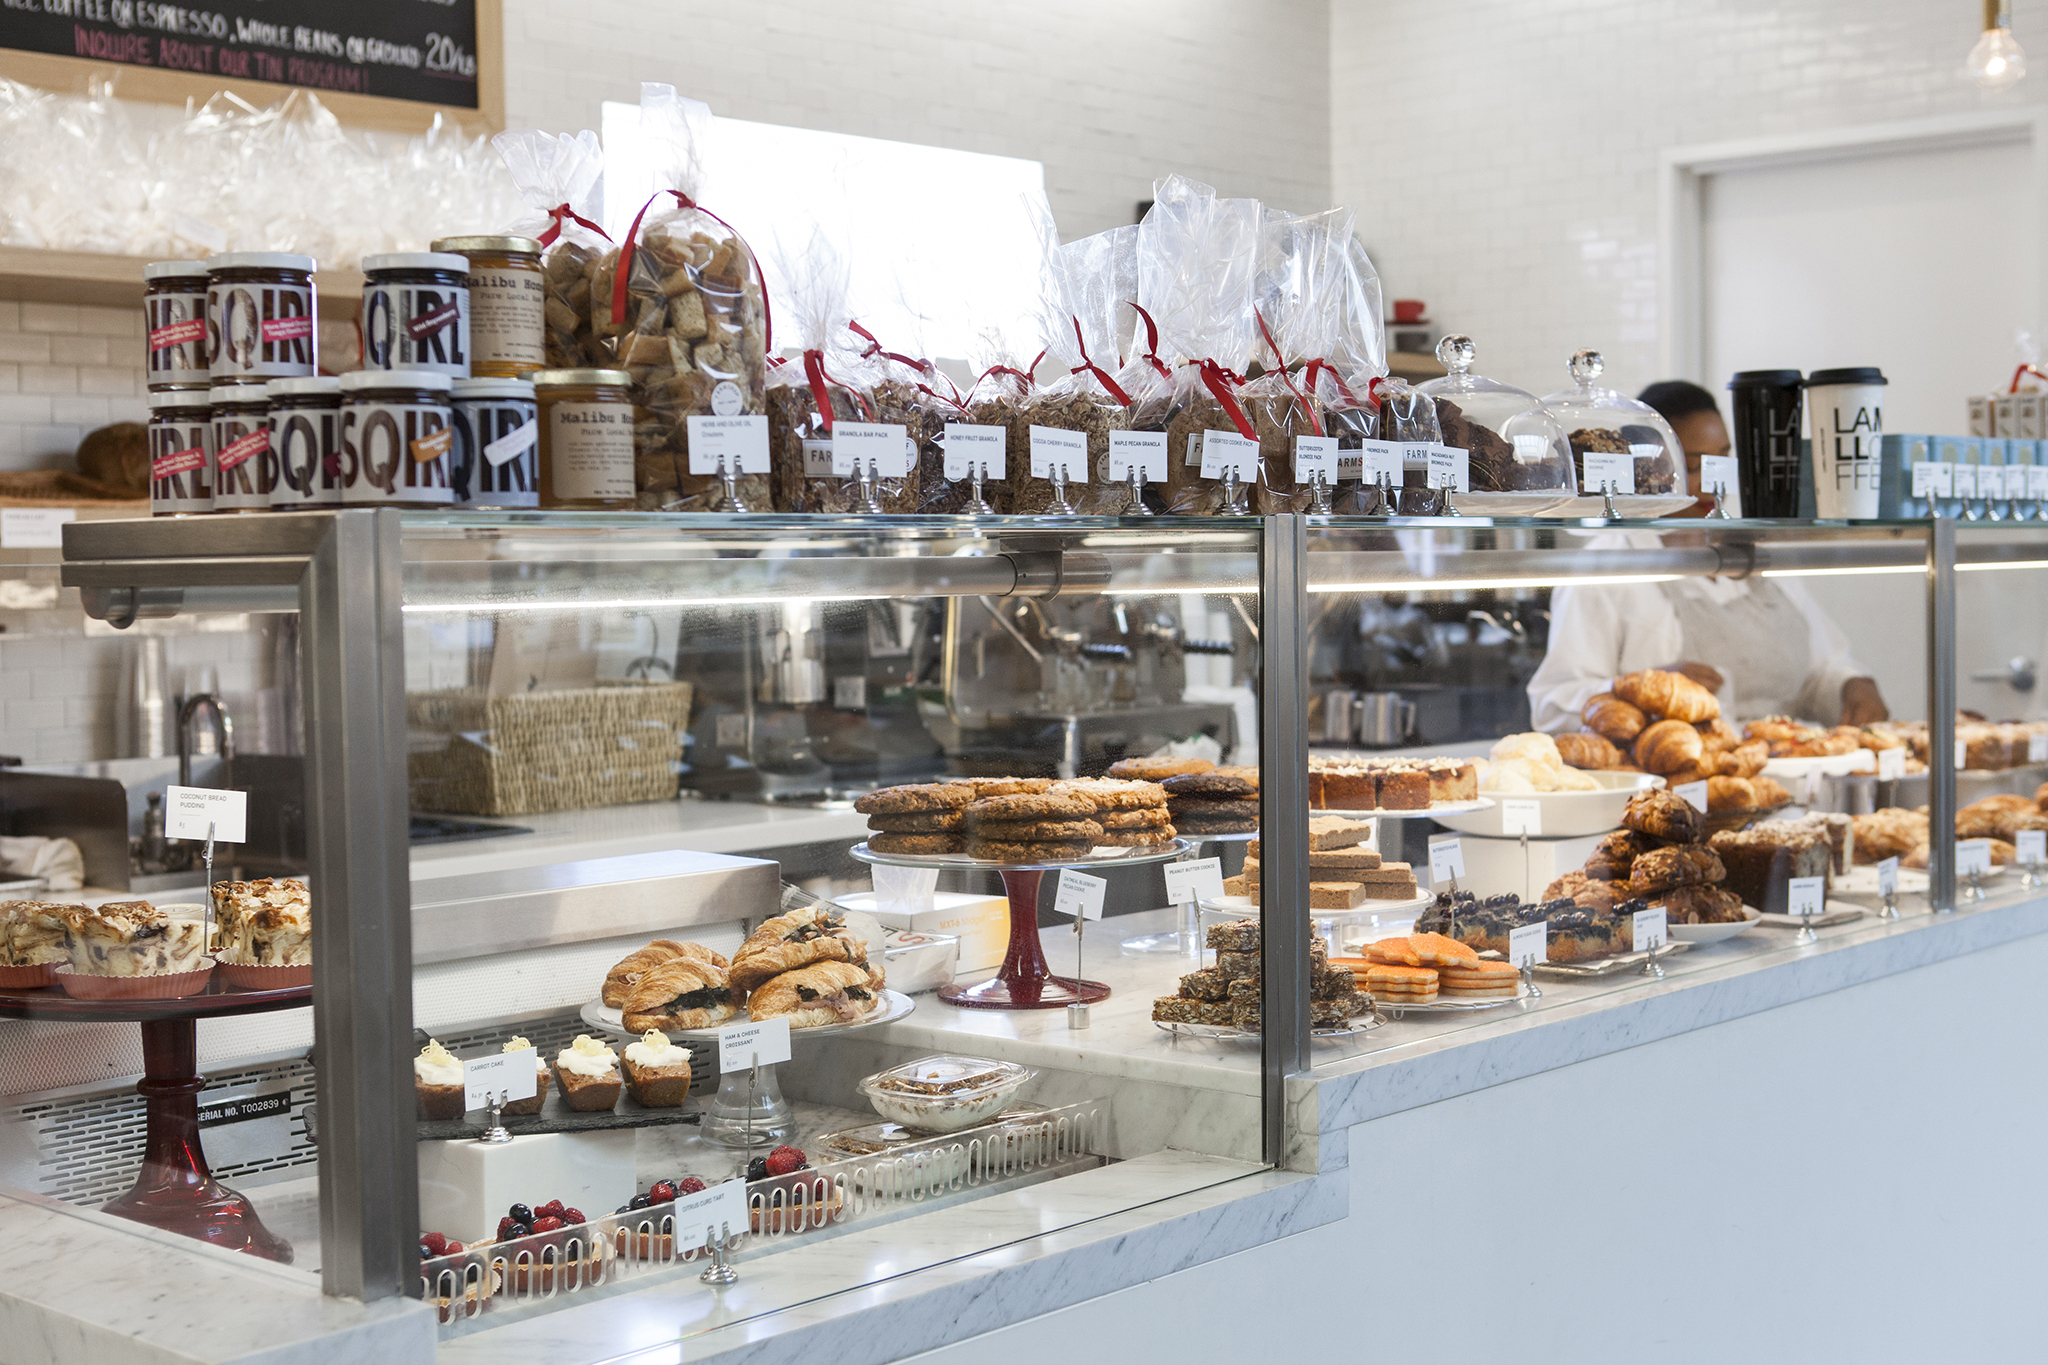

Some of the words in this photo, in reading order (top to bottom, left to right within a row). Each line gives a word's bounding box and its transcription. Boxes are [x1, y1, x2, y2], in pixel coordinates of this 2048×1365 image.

[74, 23, 151, 64] INQUIRE
[159, 37, 214, 73] ABOUT
[811, 450, 833, 462] FAR
[1338, 457, 1363, 468] ARMS
[180, 793, 207, 801] COCONUT
[741, 1029, 760, 1038] CHEESE
[725, 1039, 753, 1049] CROISSANT
[470, 1063, 490, 1072] CARROT
[490, 1060, 505, 1068] CAKE
[224, 1107, 239, 1118] NO.
[241, 1099, 280, 1114] T002839
[682, 1202, 700, 1213] CITRUS
[699, 1197, 713, 1208] CURD
[712, 1193, 725, 1203] TART
